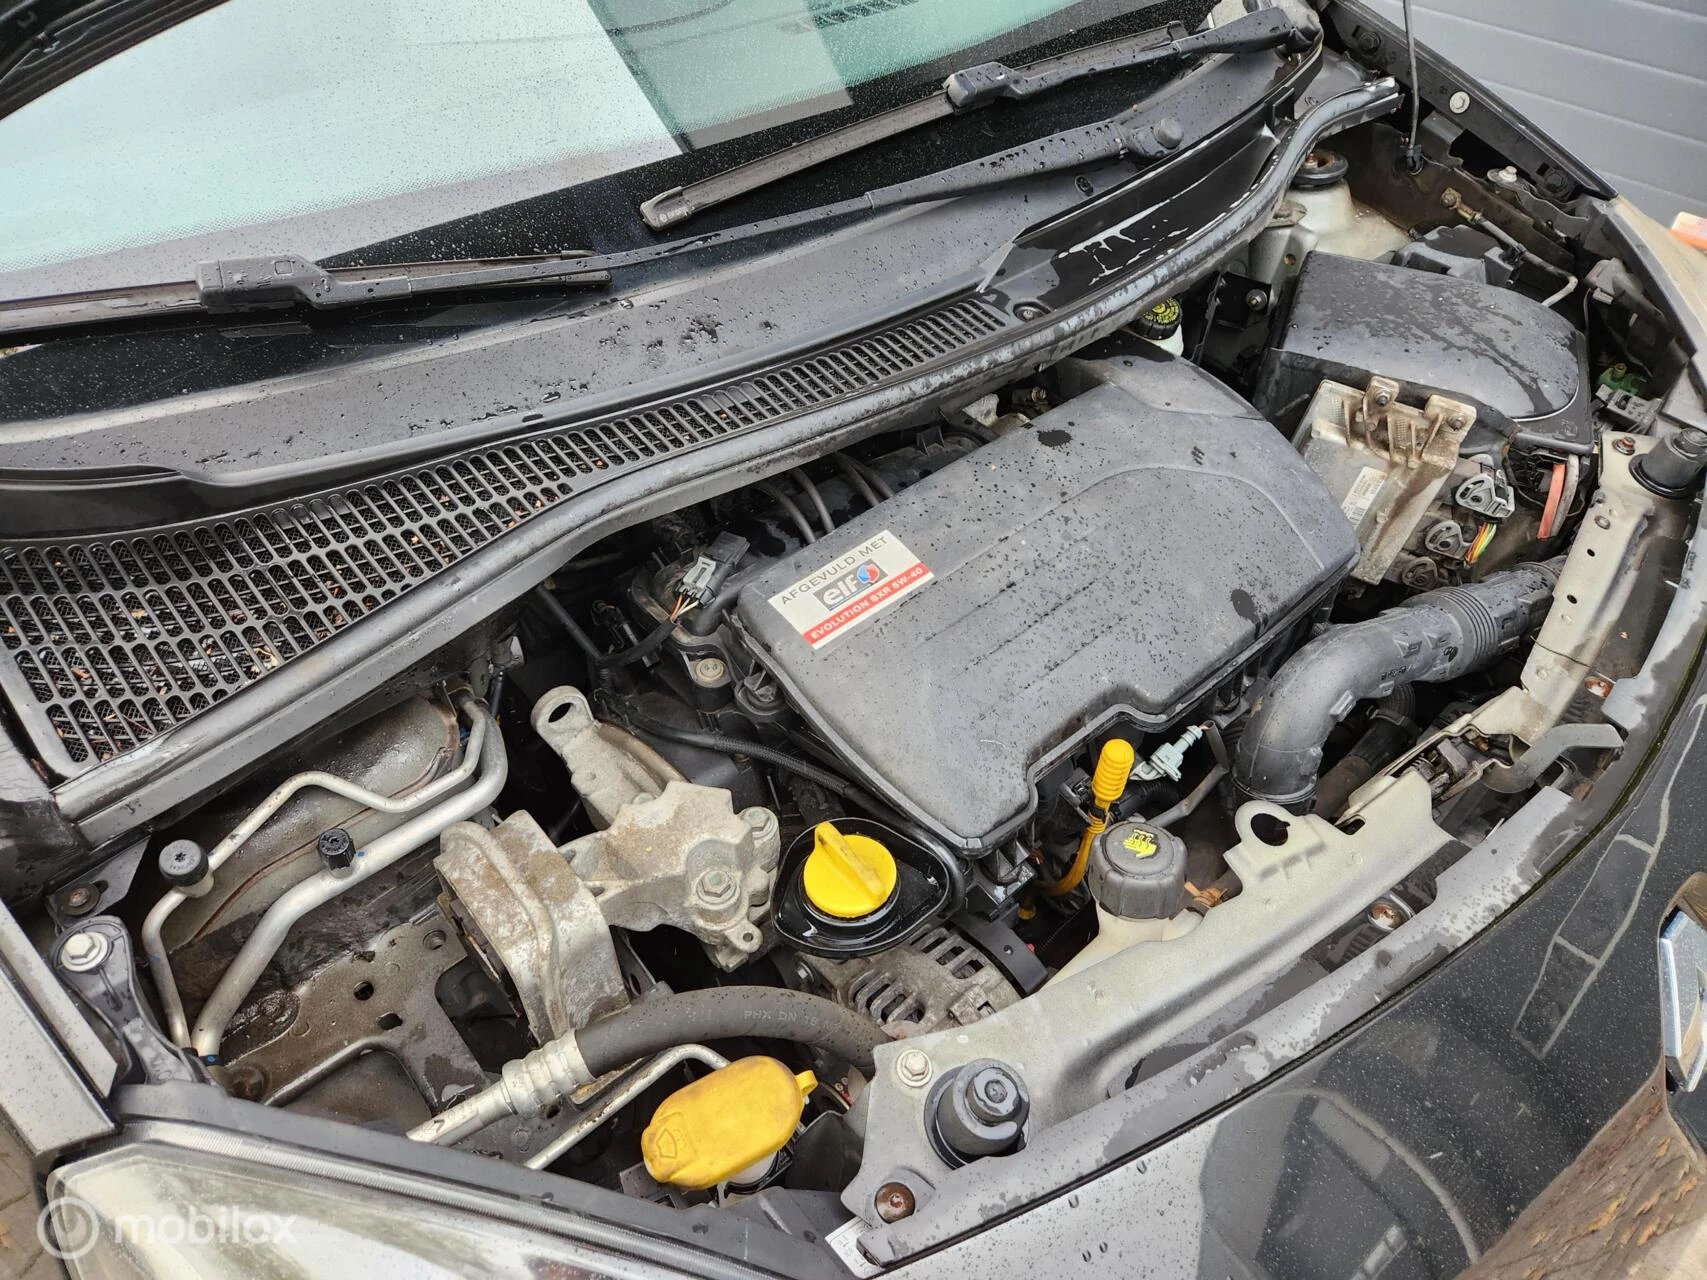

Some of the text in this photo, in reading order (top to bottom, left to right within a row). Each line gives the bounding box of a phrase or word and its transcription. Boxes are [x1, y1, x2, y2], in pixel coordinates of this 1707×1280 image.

[781, 536, 888, 604] AFGEVULD MET
[823, 574, 857, 605] elf
[811, 568, 924, 639] EVOLUTION SXR 5W-40
[744, 1009, 771, 1020] PHX
[779, 1011, 797, 1021] DN
